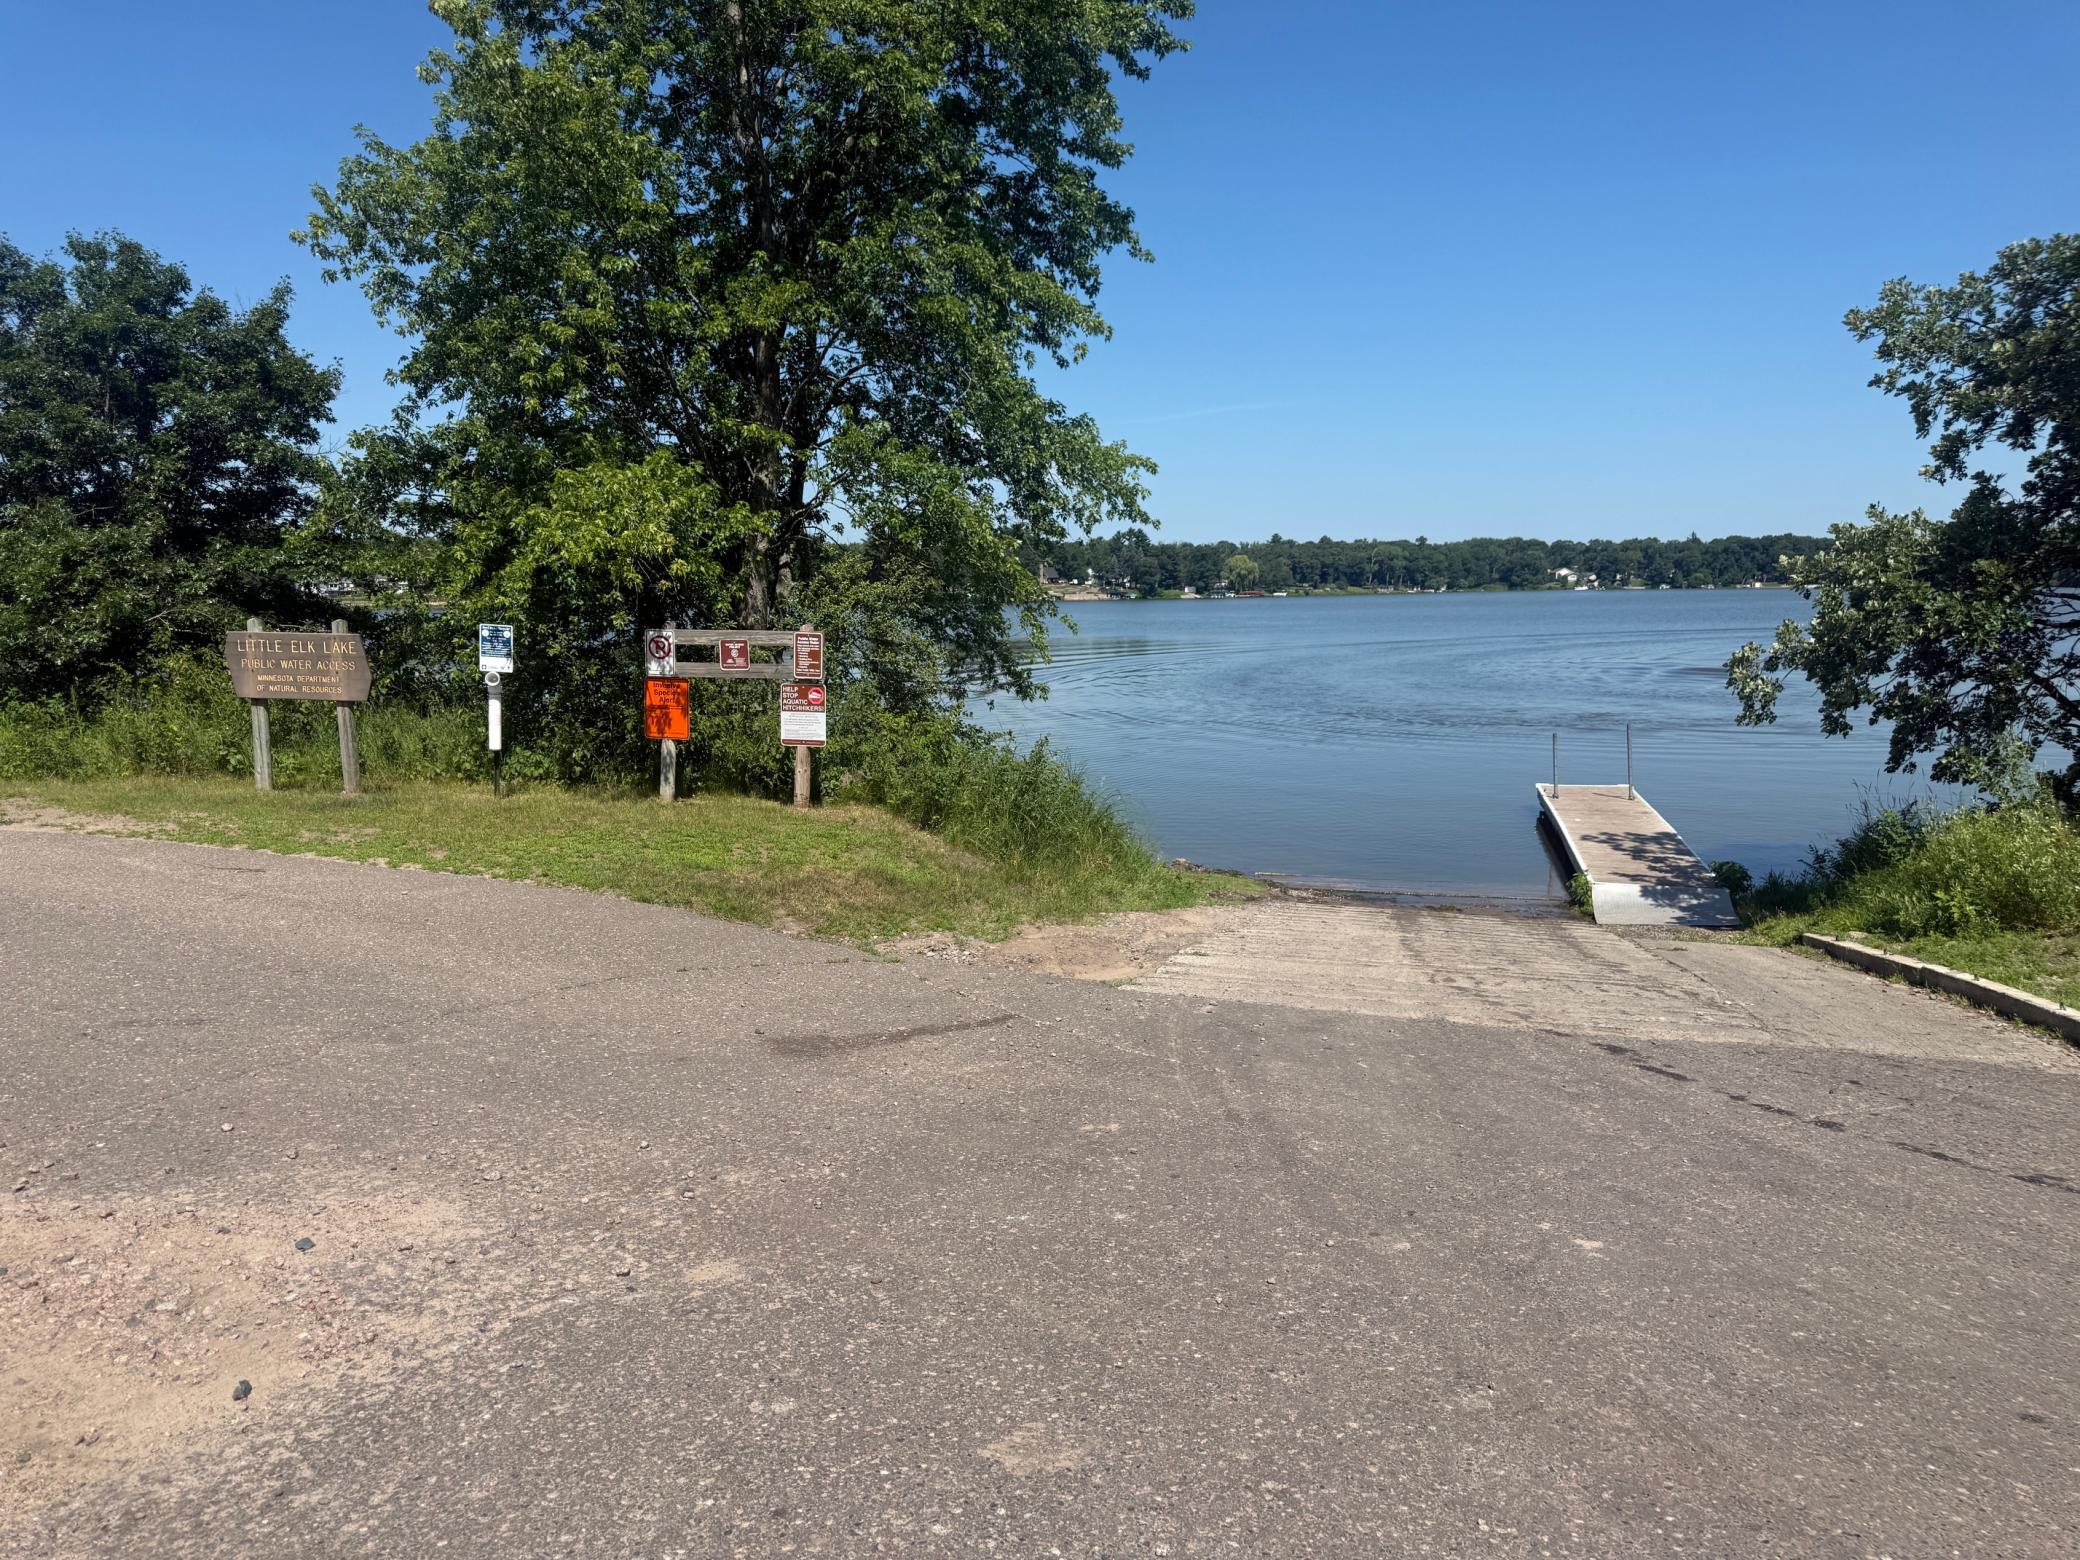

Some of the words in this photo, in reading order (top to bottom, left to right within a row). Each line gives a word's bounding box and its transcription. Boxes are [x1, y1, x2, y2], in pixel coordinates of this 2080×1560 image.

[237, 640, 282, 652] LITTLE
[290, 640, 315, 653] ELK
[323, 641, 357, 655] LAKE
[241, 659, 276, 669] PUBLIC
[280, 660, 312, 670] WATER
[316, 660, 356, 671] ACCESS
[257, 674, 294, 682] MINNESOTA
[297, 675, 340, 683] DEPARTMENT
[256, 684, 265, 692] OF
[269, 685, 299, 693] NATURAL
[302, 685, 342, 694] RESOURCES
